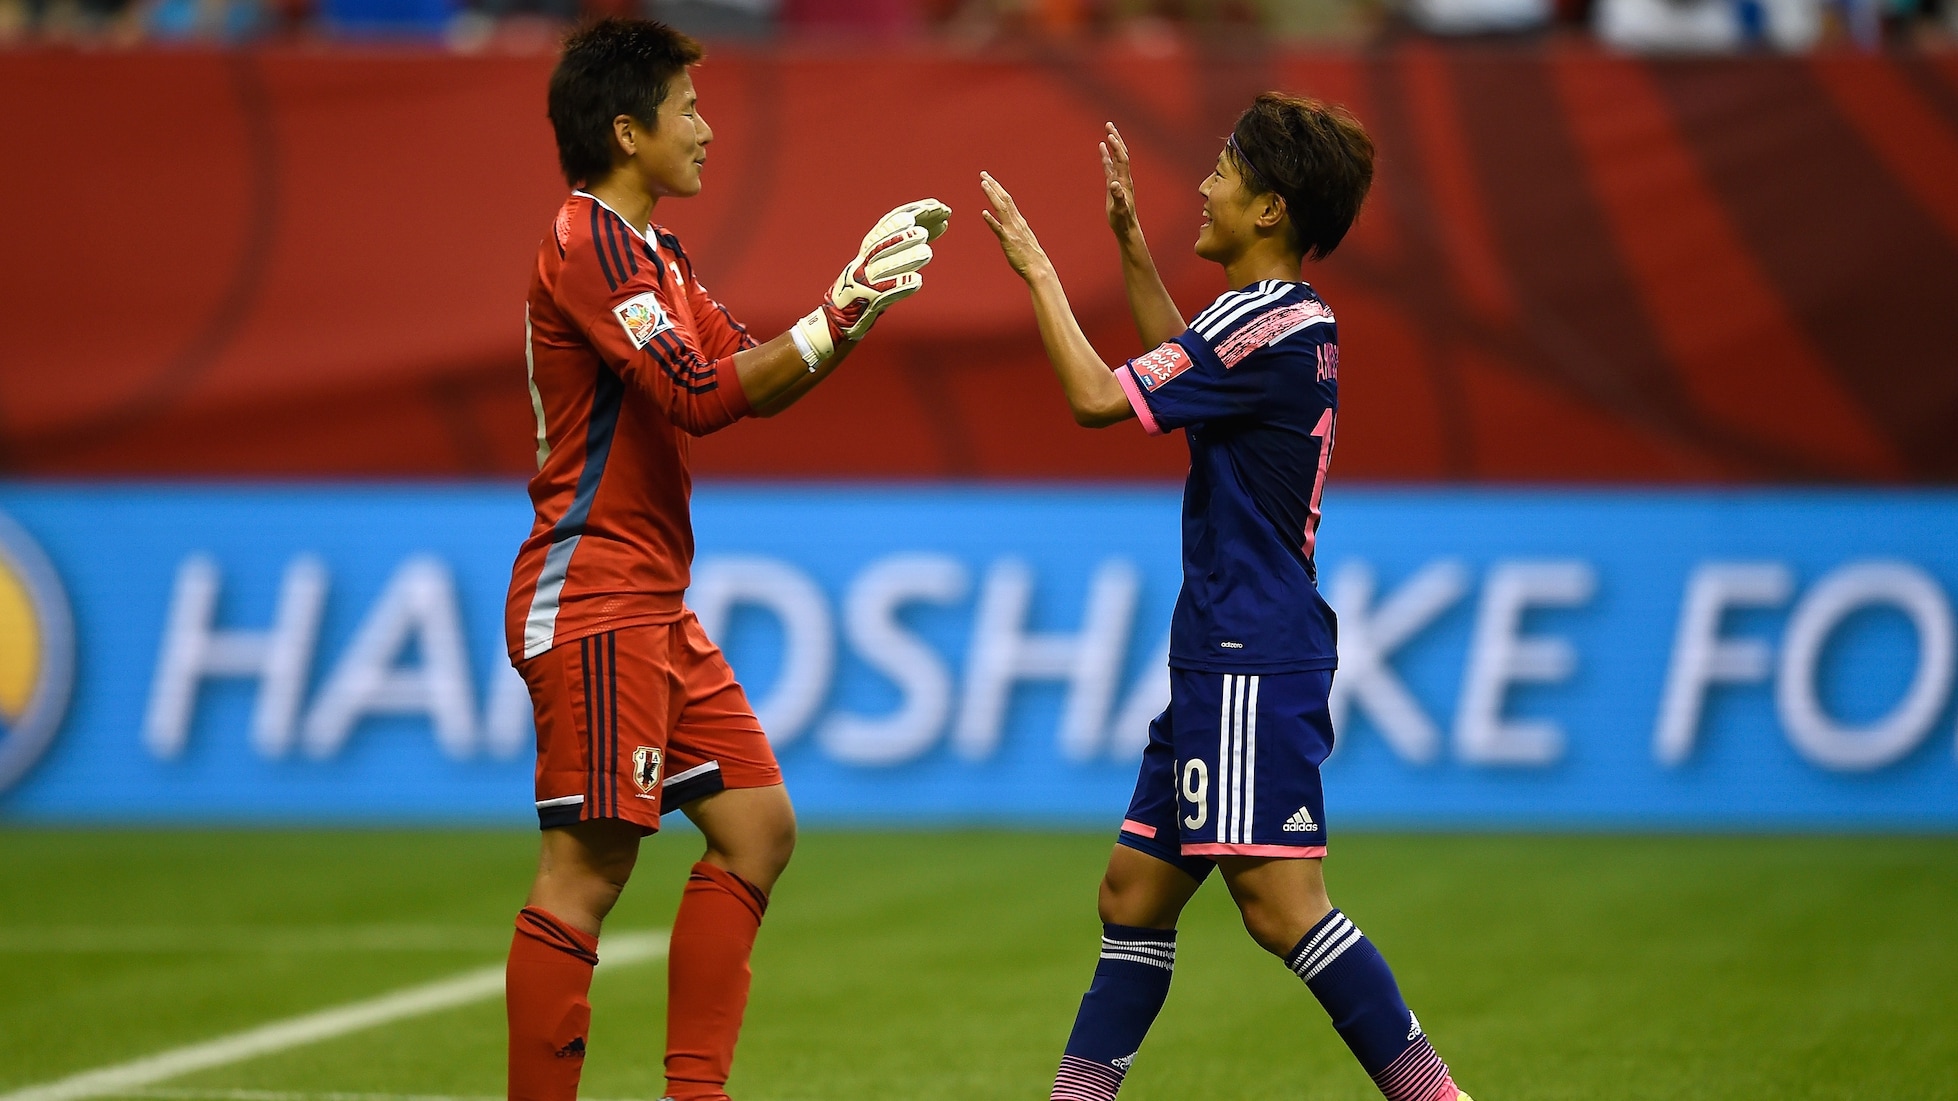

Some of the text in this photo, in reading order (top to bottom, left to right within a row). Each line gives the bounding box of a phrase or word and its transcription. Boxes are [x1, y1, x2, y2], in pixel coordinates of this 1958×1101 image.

[1137, 358, 1171, 380] GOALS
[1301, 408, 1337, 559] 1
[1221, 641, 1243, 649] adizero
[143, 554, 1958, 770] HADSHKE FO
[1282, 821, 1318, 832] adidas
